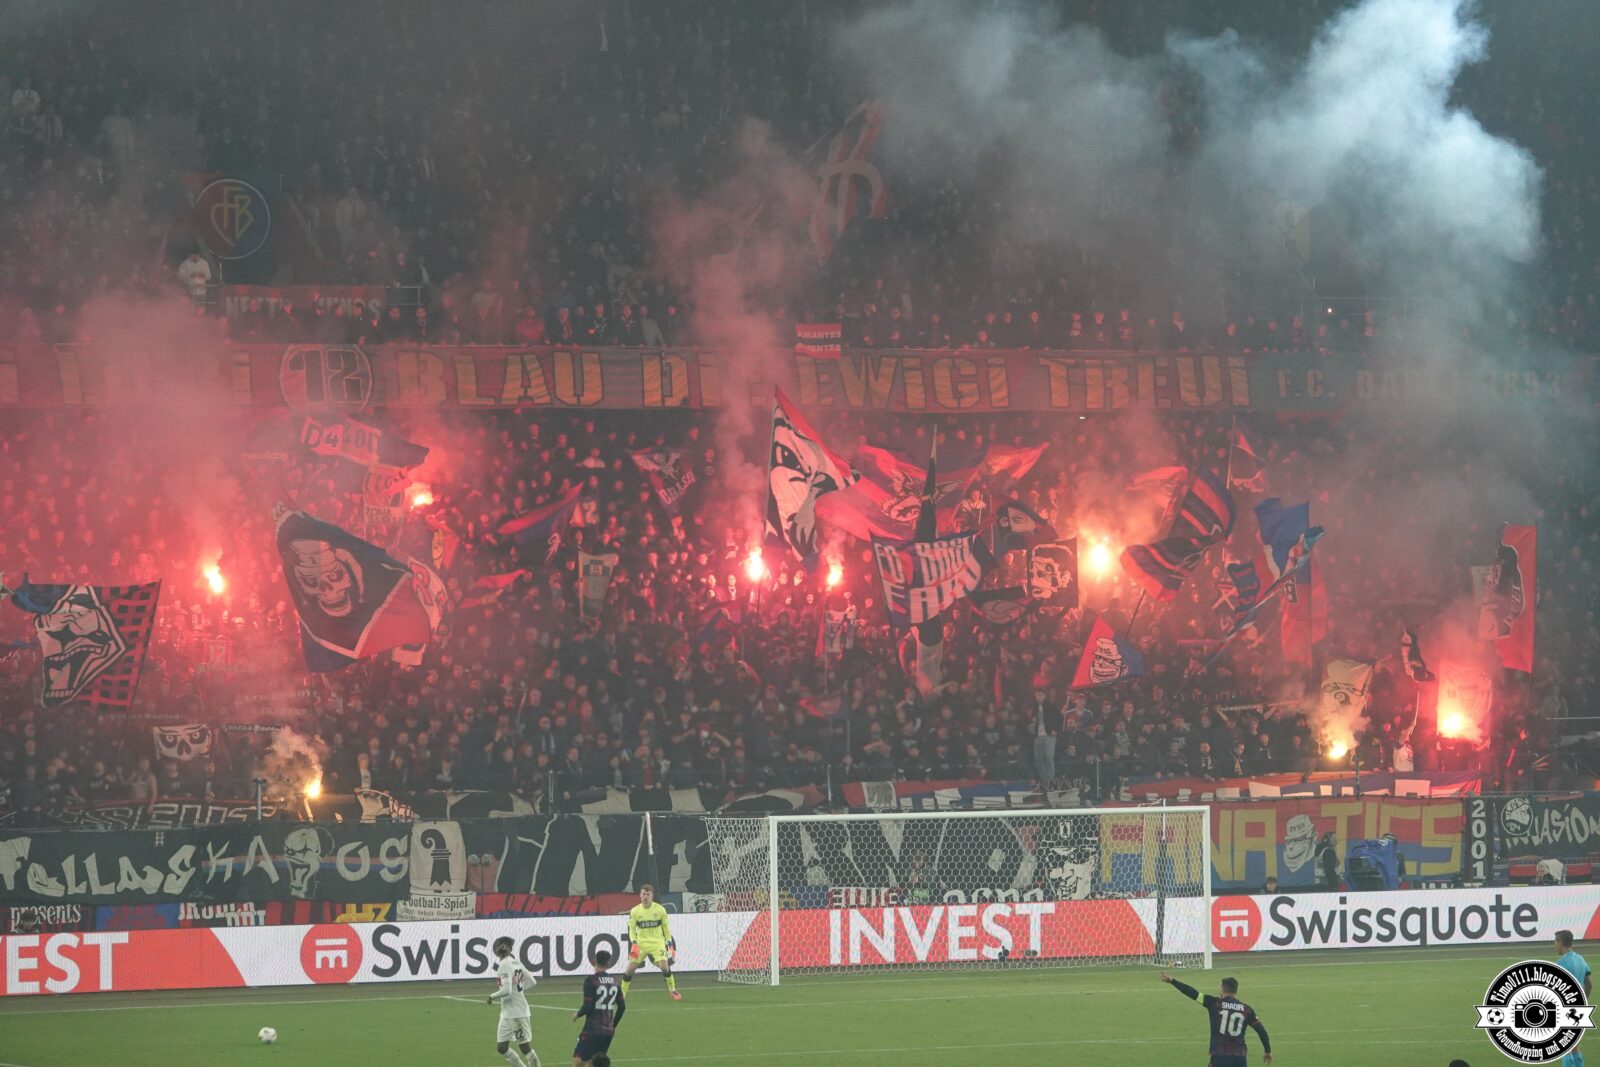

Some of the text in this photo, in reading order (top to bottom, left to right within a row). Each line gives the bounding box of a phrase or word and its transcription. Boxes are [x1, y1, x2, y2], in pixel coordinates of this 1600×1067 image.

[1470, 798, 1488, 881] 2001
[829, 902, 1056, 965] INVEST
[1268, 894, 1539, 946] Swissquote
[0, 931, 130, 995] EST
[595, 984, 618, 1010] 22
[1218, 1009, 1245, 1037] 10
